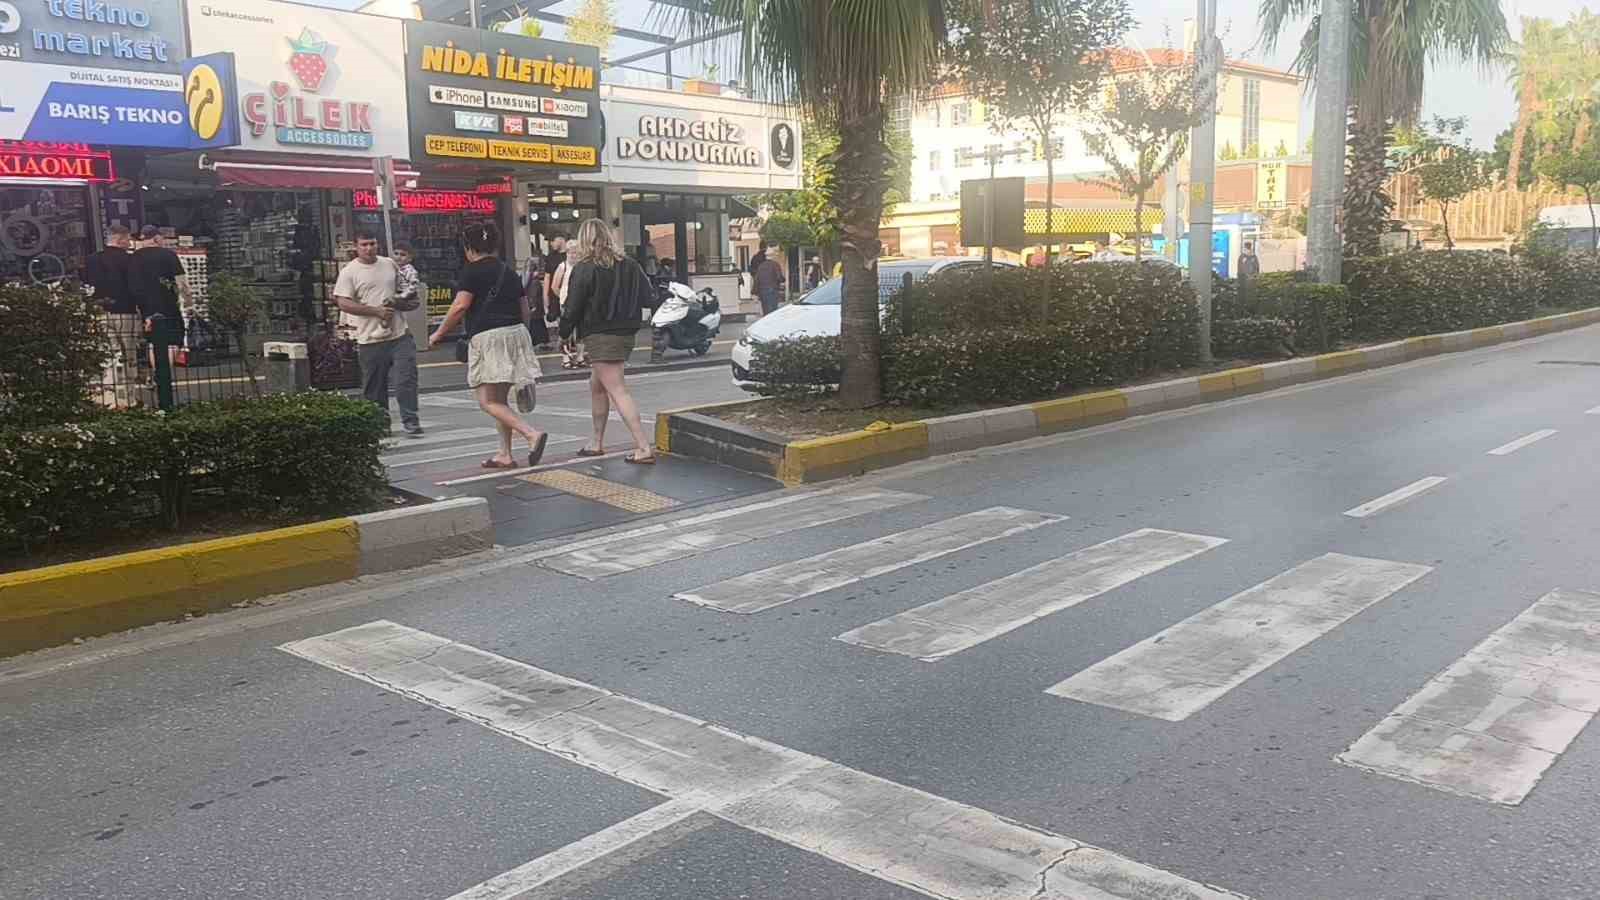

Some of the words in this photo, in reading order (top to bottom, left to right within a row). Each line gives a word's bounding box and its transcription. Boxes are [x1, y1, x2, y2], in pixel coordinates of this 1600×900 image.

[46, 0, 149, 27] tekno
[33, 28, 168, 62] market
[421, 40, 489, 77] NİDA
[496, 49, 593, 93] İLETİŞİM
[446, 90, 482, 105] iPhone
[490, 96, 537, 110] SAMSUNG
[49, 101, 110, 124] BARIŞ
[115, 106, 183, 125] TEKNO
[287, 130, 368, 146] ACCESSORIES
[640, 115, 742, 142] AKDENİZ
[429, 139, 445, 151] CEP
[446, 141, 484, 154] TELEFONU
[618, 138, 761, 167] DONDURMA
